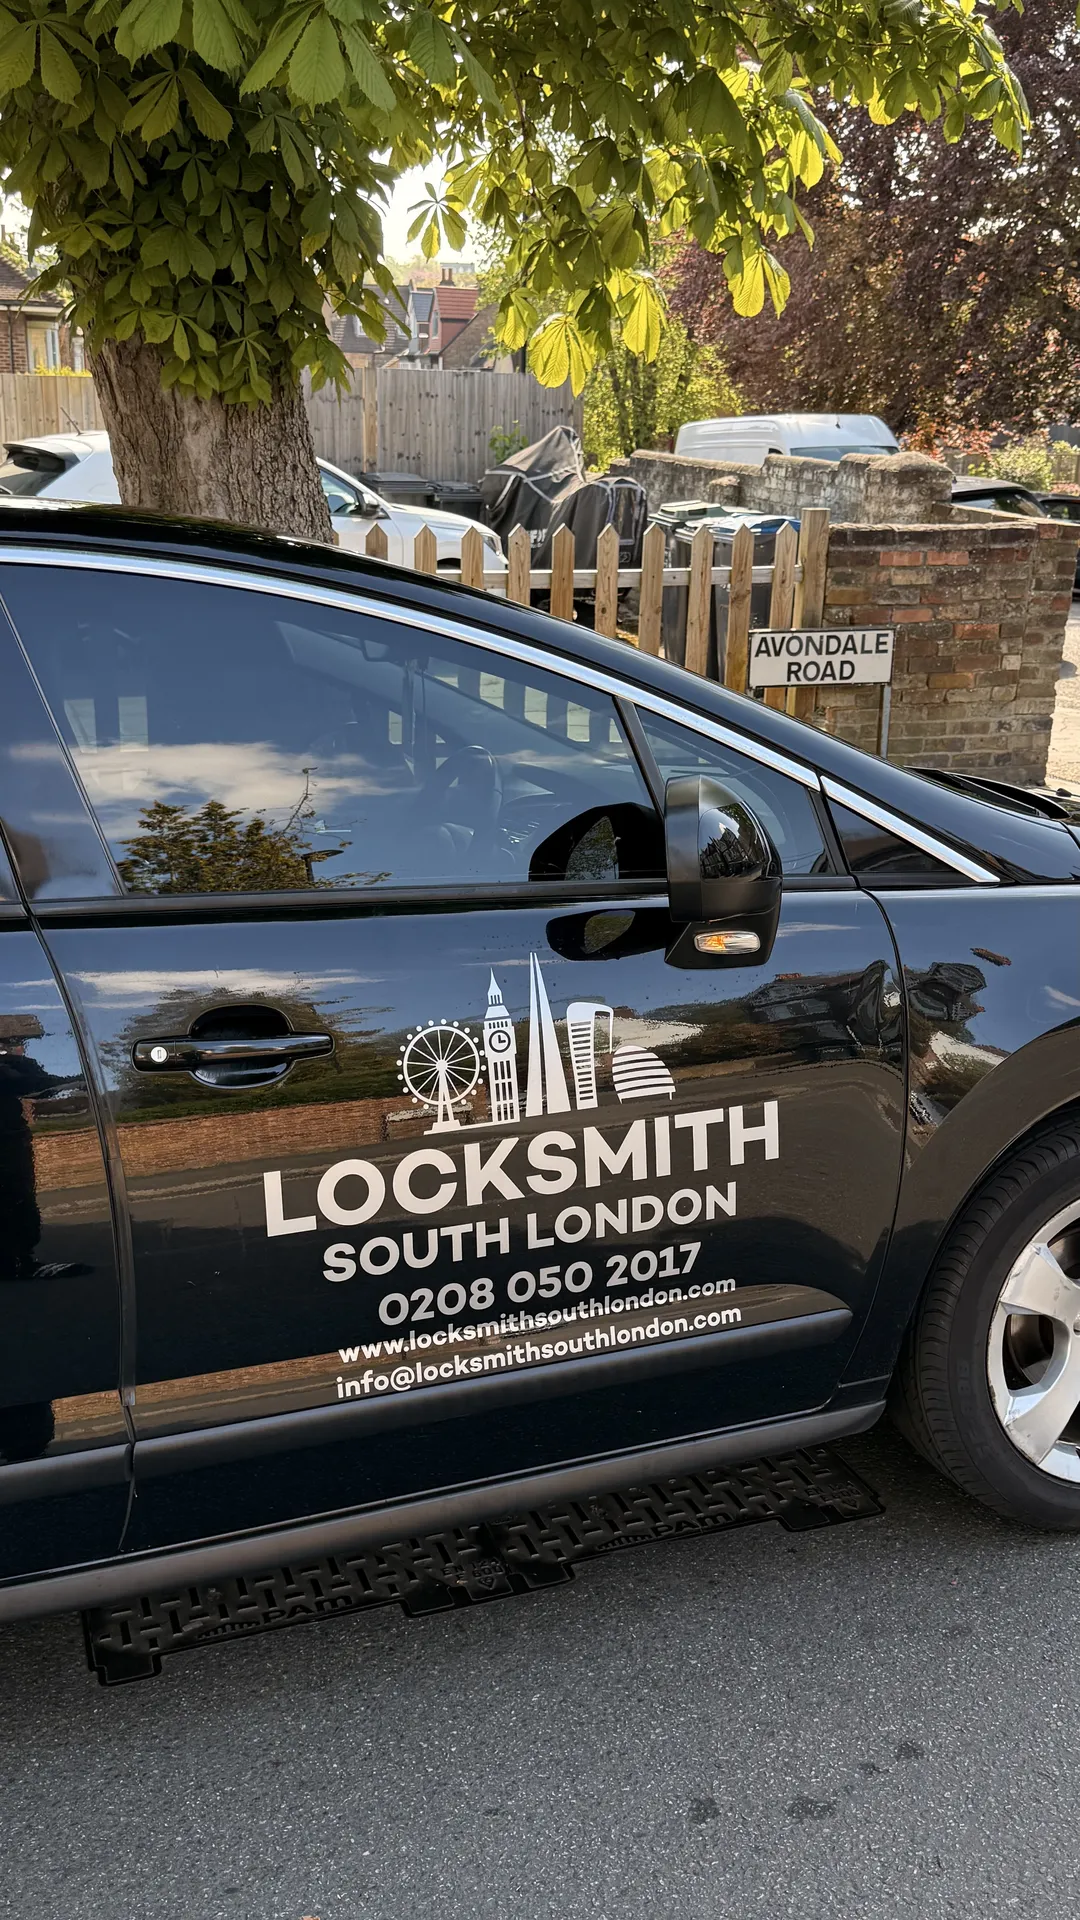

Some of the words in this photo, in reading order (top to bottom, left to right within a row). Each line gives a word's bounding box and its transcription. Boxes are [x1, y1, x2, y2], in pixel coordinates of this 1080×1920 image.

[754, 633, 889, 657] AVONDALE
[786, 660, 855, 682] ROAD
[264, 1100, 779, 1237] LOCKSMITH
[322, 1217, 510, 1282] SOUTH
[527, 1182, 737, 1249] LONDON
[338, 1277, 736, 1363] www.locksmithsouthlondon.com
[377, 1277, 495, 1326] 0208
[507, 1261, 593, 1304] 050
[605, 1241, 702, 1287] 2017
[336, 1306, 742, 1398] info@locksmithsouthlondon.com
